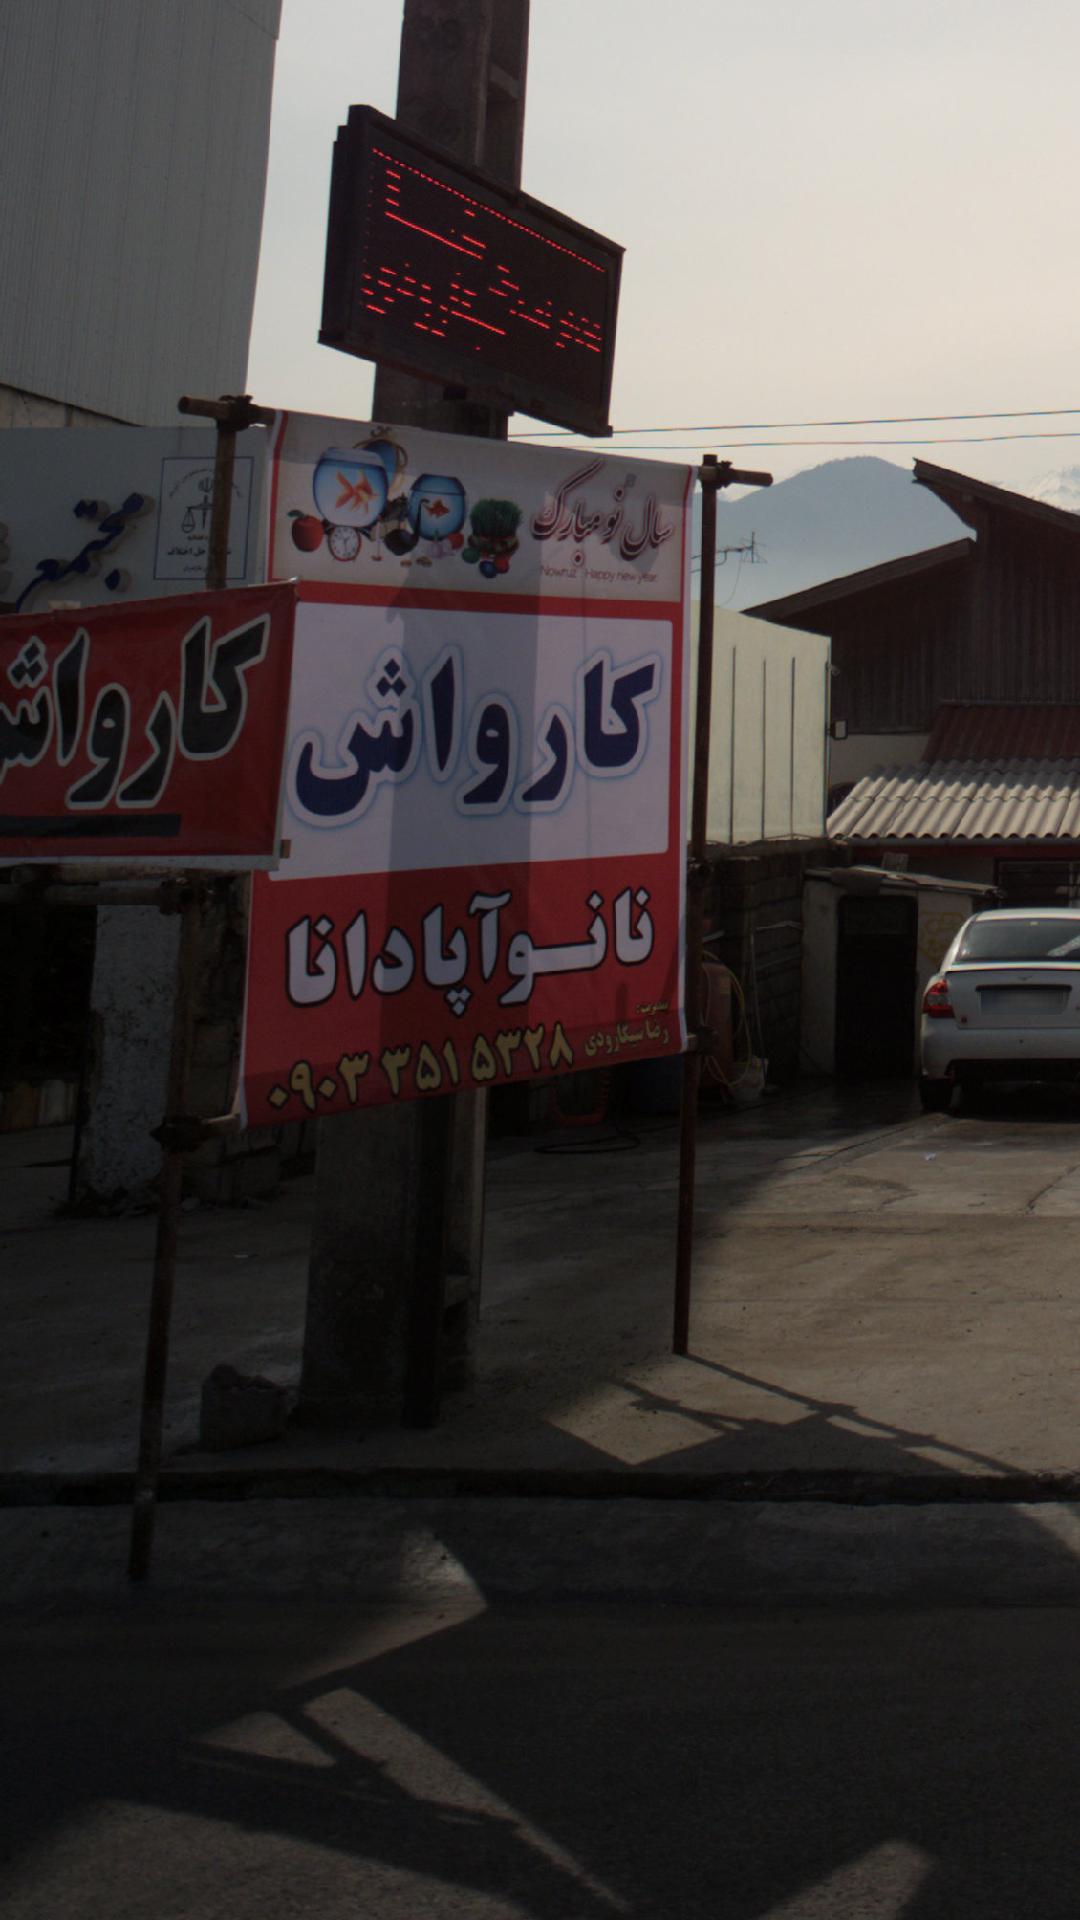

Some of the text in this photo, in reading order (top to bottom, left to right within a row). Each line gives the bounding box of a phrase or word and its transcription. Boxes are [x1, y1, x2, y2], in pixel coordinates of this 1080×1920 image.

[530, 456, 674, 567] سال نو مبارک
[293, 653, 659, 818] کارواش
[285, 886, 654, 1018] نانو آپادانا
